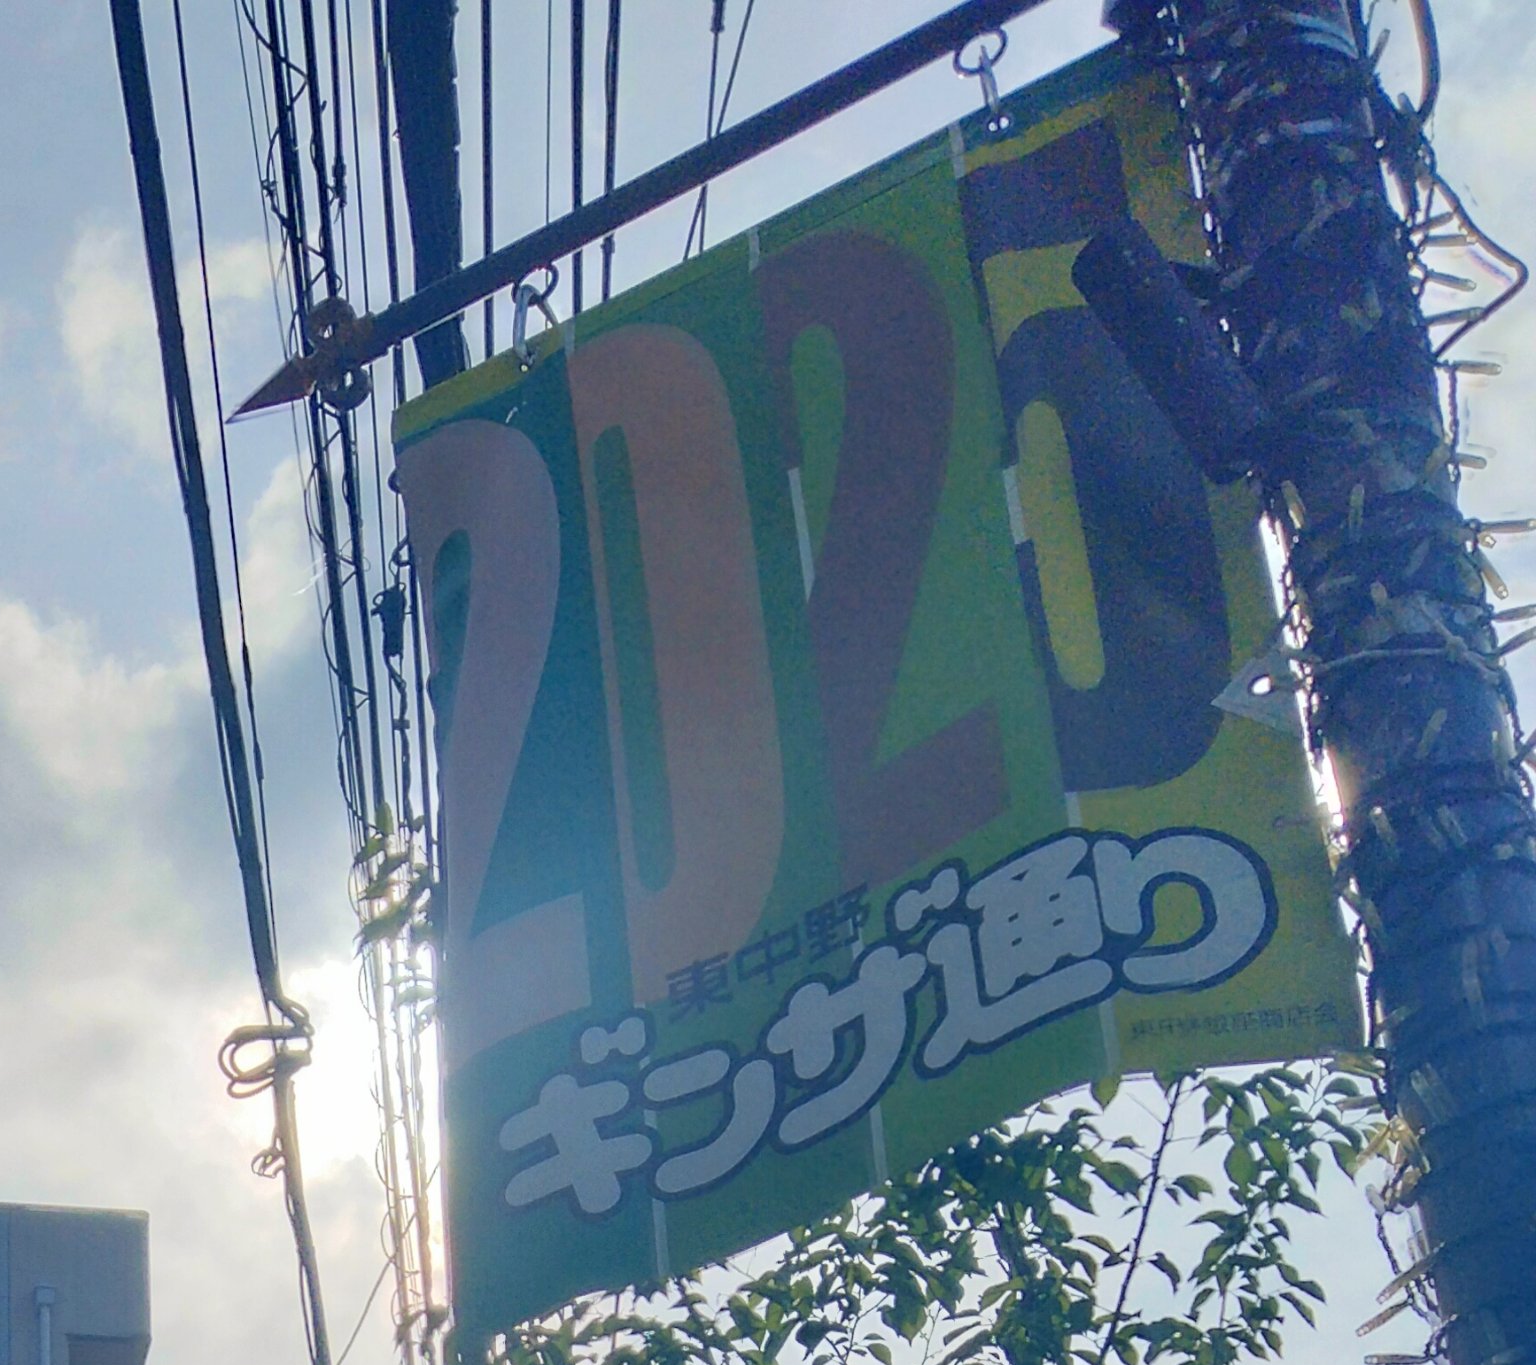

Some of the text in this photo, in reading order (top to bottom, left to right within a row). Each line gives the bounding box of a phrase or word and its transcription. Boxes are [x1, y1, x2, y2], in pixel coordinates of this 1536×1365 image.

[498, 828, 1277, 1216] ギンザ通り
[665, 888, 873, 1023] 東中野
